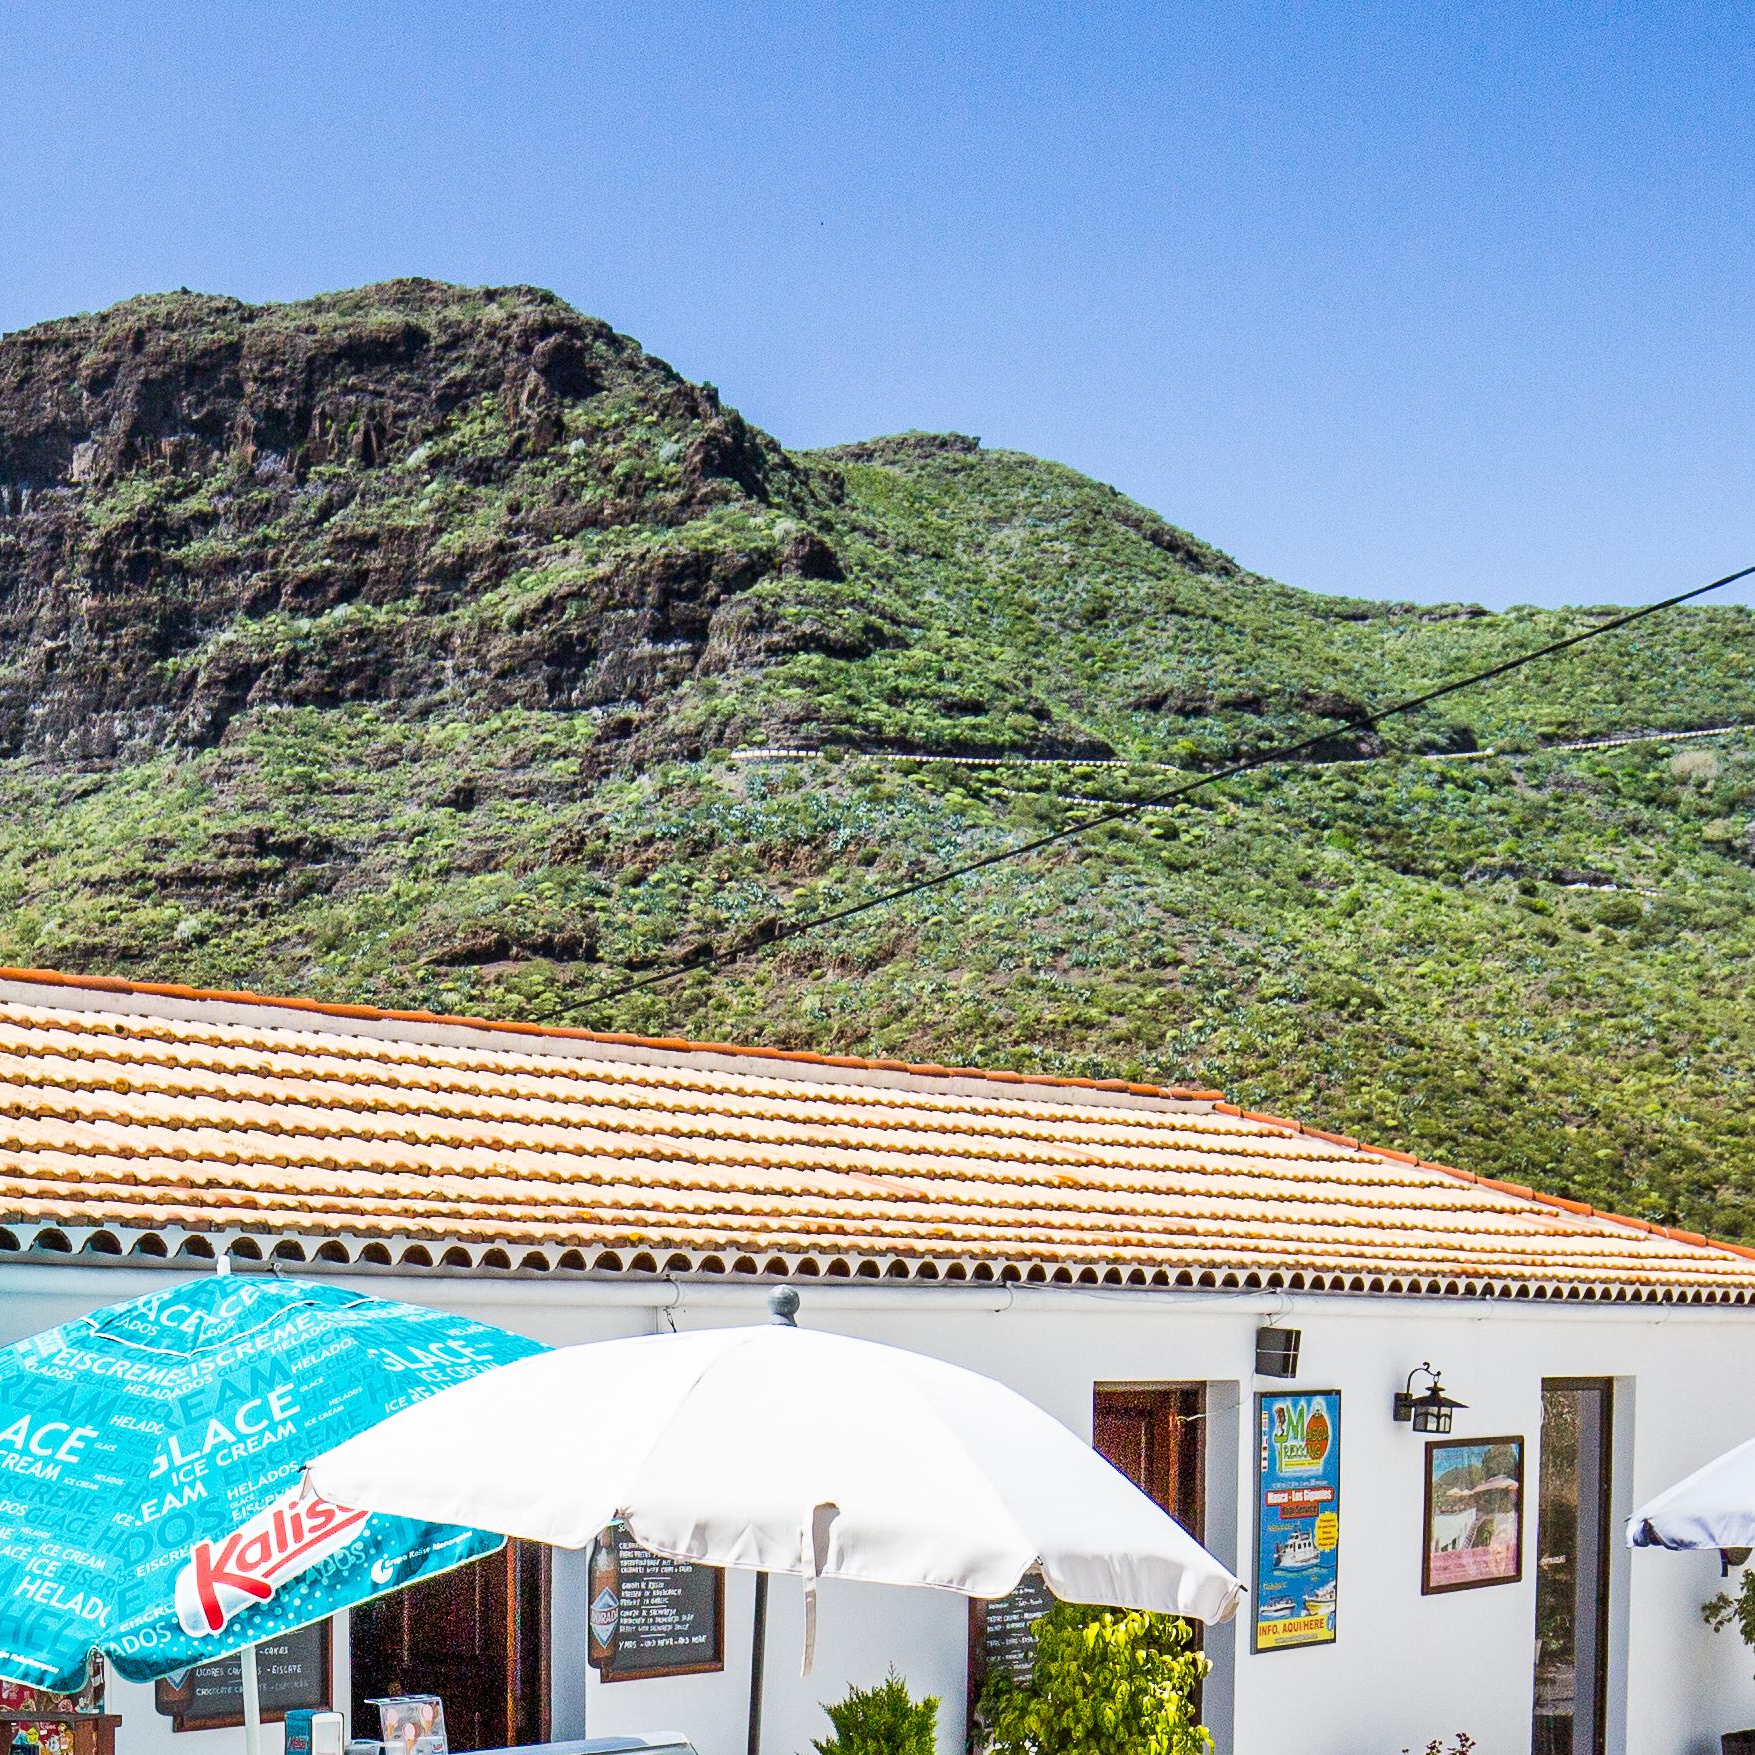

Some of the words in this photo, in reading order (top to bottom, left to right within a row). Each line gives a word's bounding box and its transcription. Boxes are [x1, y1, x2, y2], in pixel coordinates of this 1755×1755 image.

[171, 1457, 210, 1487] ICE
[215, 1420, 297, 1467] CREAM
[227, 1460, 299, 1501] HELADOS
[25, 1555, 63, 1578] ICE
[37, 1543, 61, 1558] ICE
[62, 1548, 108, 1571] CREAM
[195, 1499, 357, 1631] Kalis
[1259, 1624, 1280, 1637] INFO.
